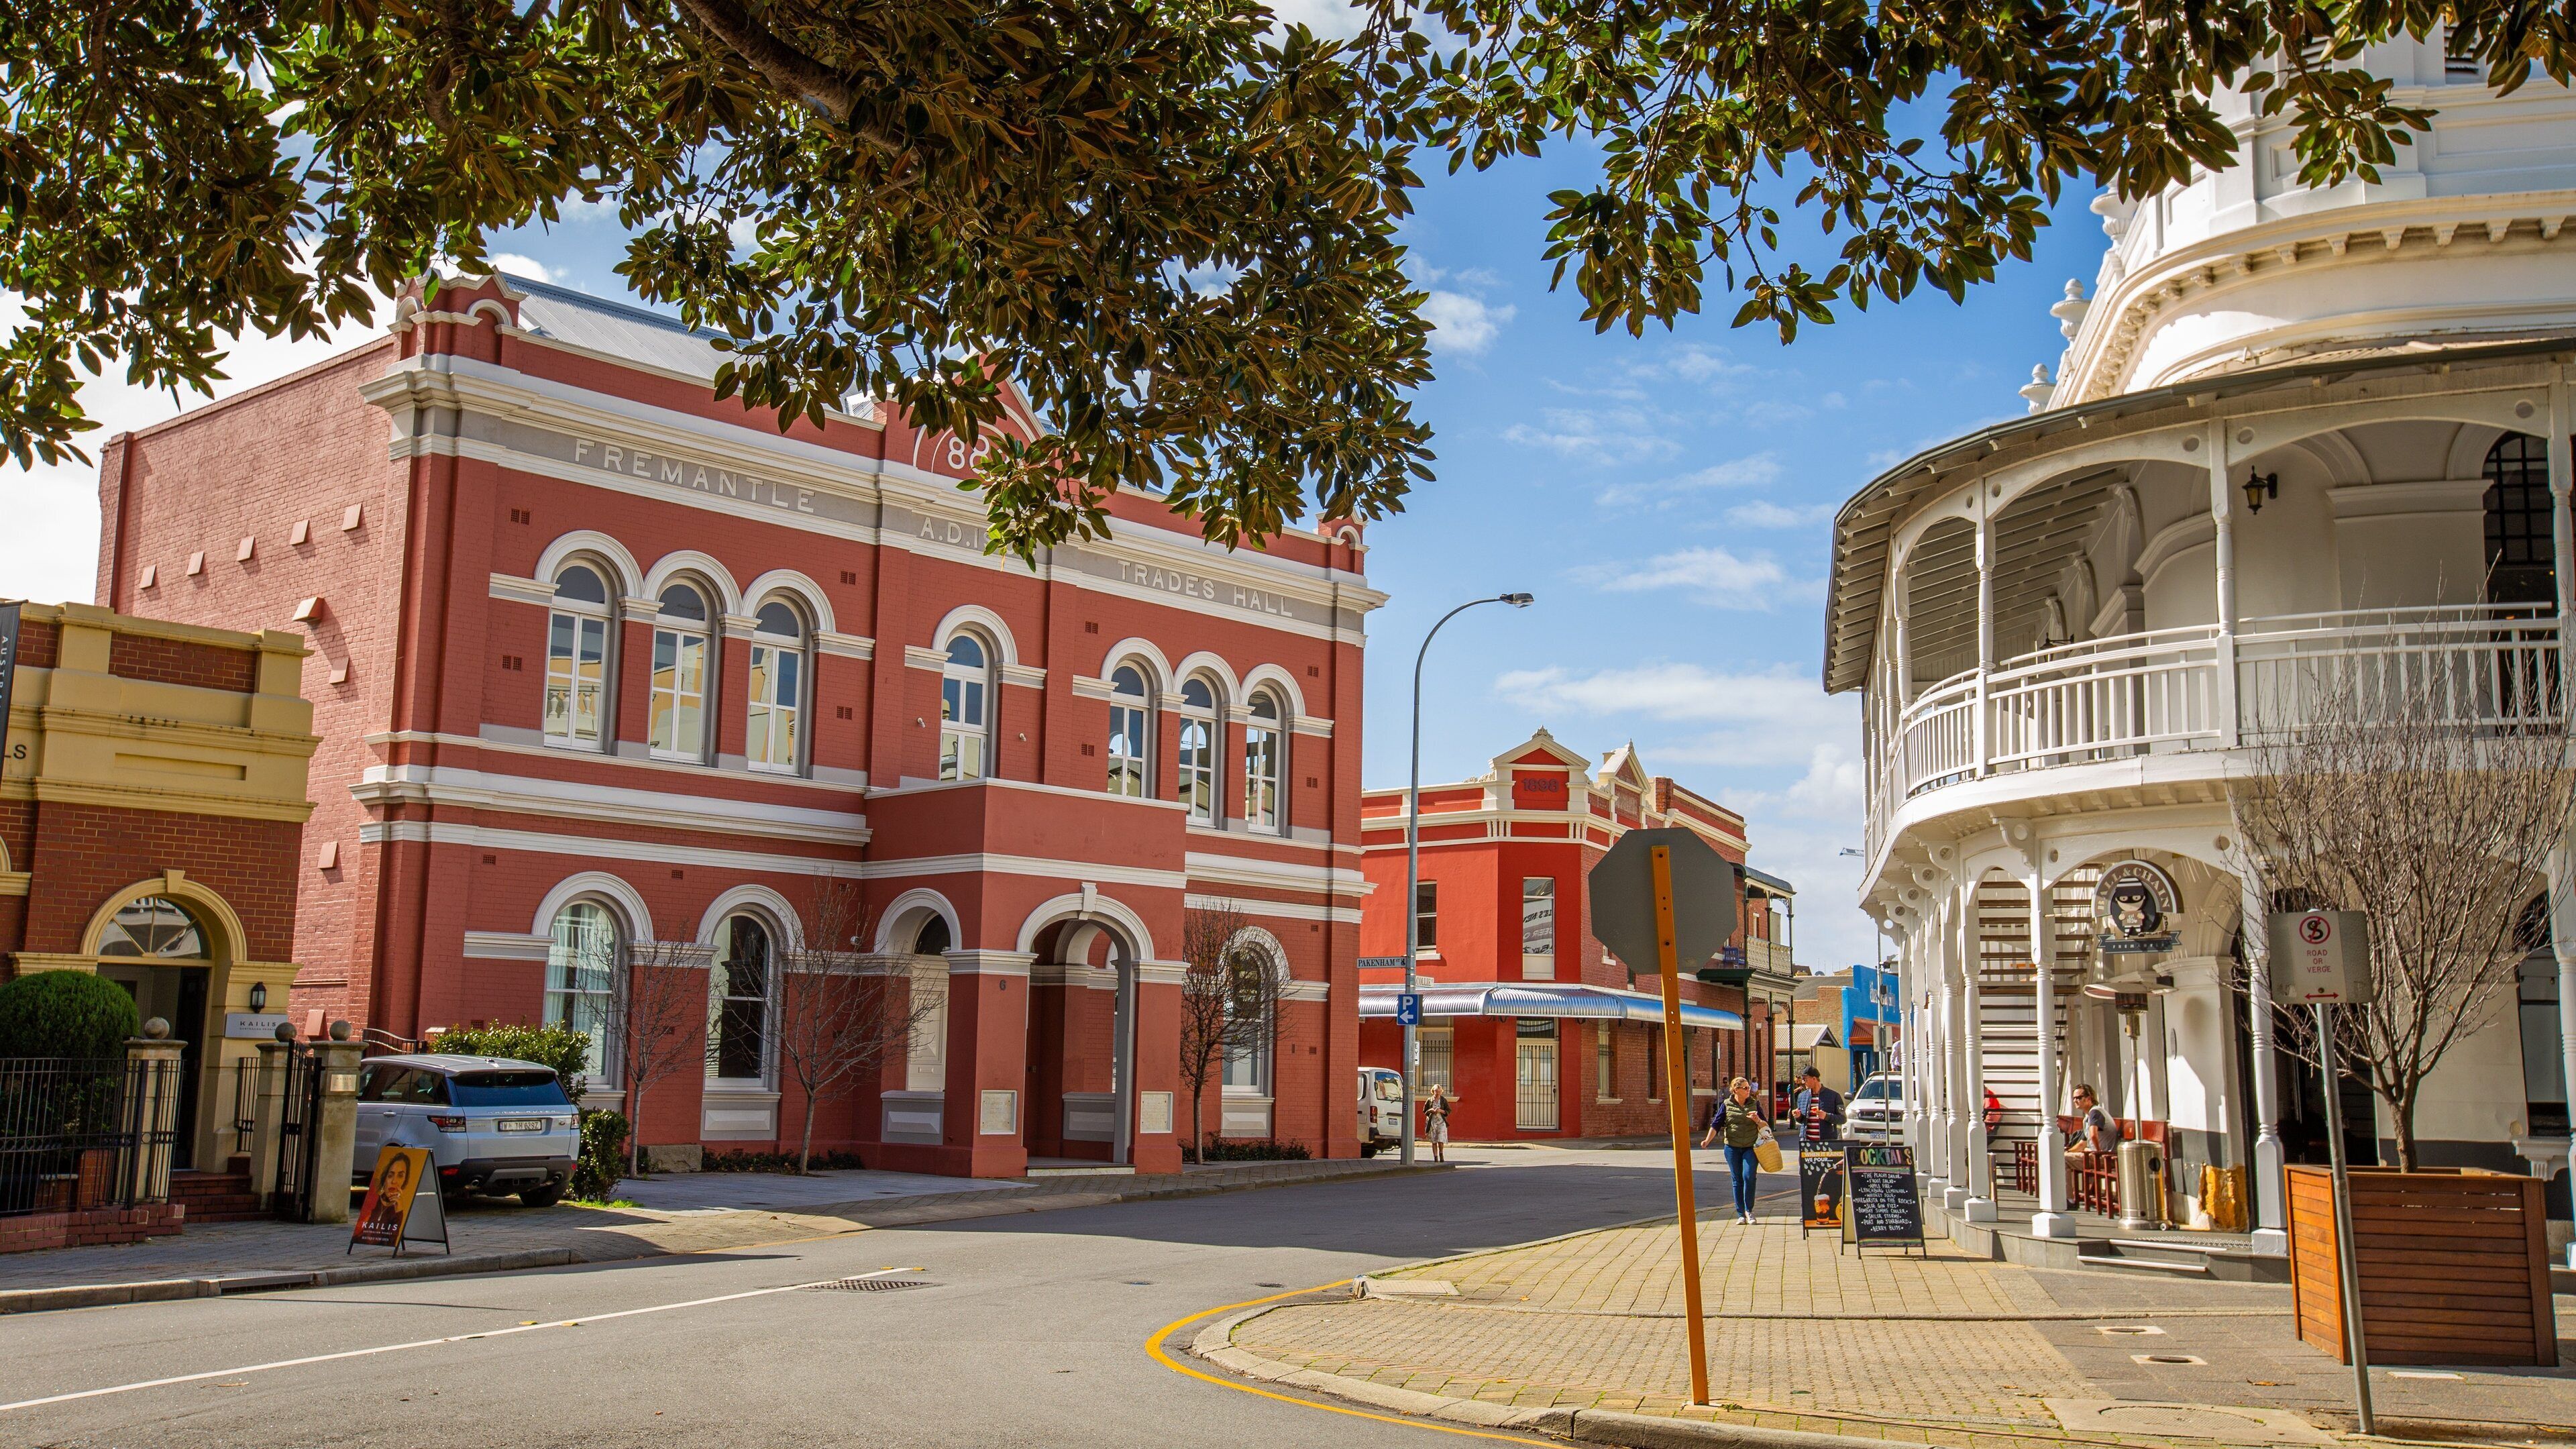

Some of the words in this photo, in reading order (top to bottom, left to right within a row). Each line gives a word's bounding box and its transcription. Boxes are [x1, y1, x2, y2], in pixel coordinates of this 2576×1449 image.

[575, 437, 815, 513] FREMANTLE
[1117, 559, 1216, 600] TRADES
[1233, 586, 1293, 617] HALL
[1522, 778, 1559, 792] 1898
[2098, 873, 2121, 910] BALL
[2123, 867, 2131, 876] &
[2133, 867, 2170, 908] CHAIN
[1358, 958, 1395, 967] PAKENHAM
[1415, 977, 1431, 987] COLLIE
[1403, 996, 1413, 1010] P
[362, 1222, 398, 1231] KAILIS
